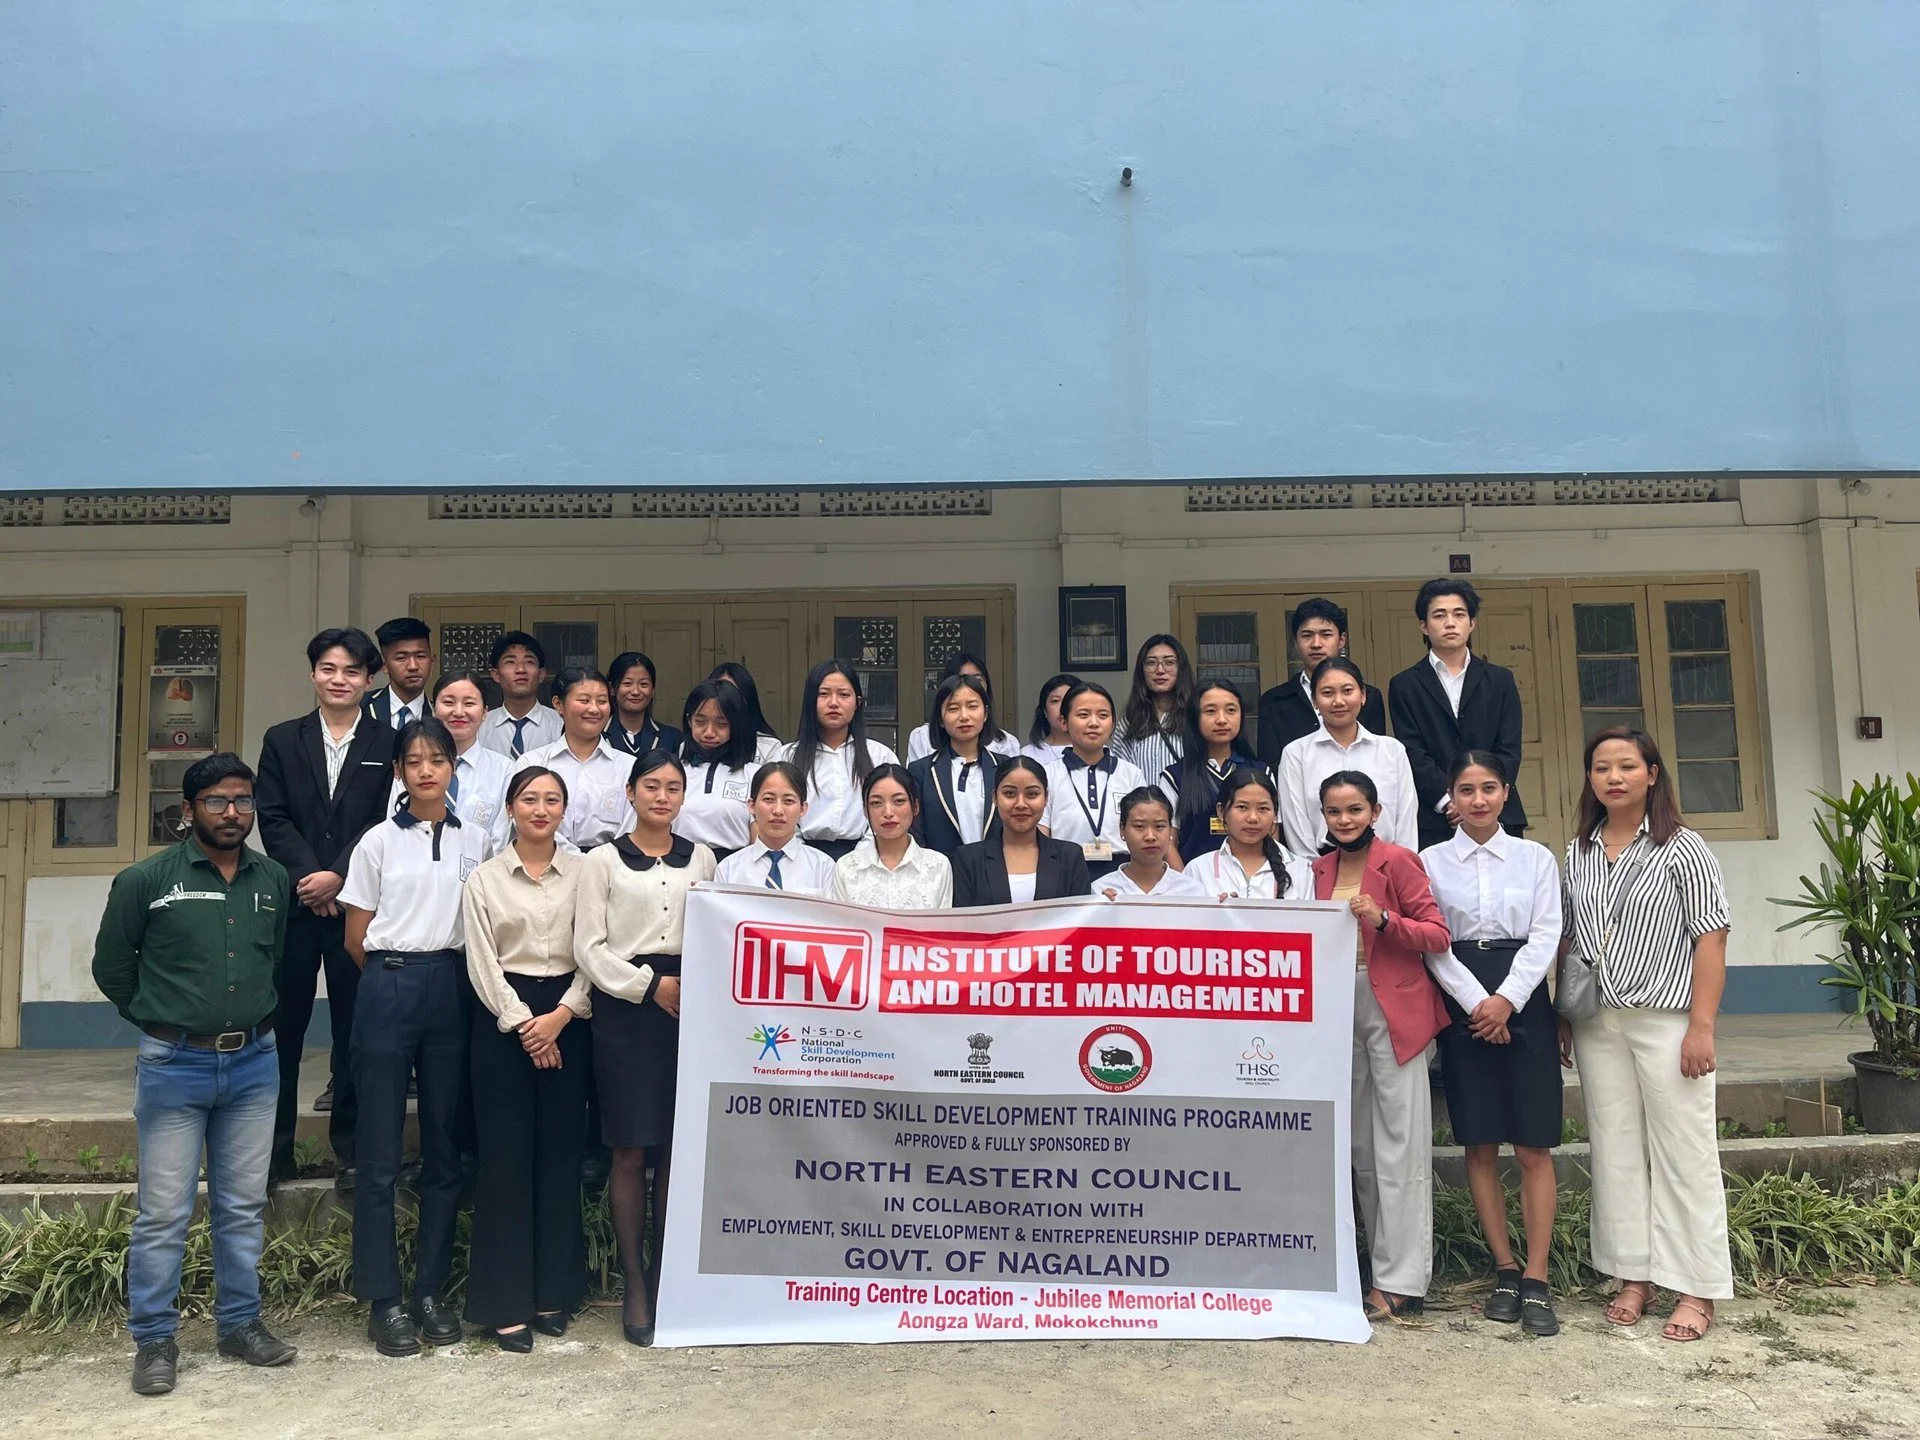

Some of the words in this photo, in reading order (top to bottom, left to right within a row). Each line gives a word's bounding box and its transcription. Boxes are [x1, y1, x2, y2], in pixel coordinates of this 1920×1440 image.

[888, 944, 1073, 973] INSTITUTE
[1081, 944, 1124, 974] OF
[1131, 946, 1302, 979] TOURISM
[886, 979, 960, 1006] AND
[969, 981, 1068, 1008] HOTEL
[1075, 982, 1305, 1014] MANAGEMENT
[801, 1038, 844, 1048] National
[801, 1045, 823, 1055] Skill
[826, 1047, 895, 1060] Development
[800, 1054, 862, 1065] Corporation
[1235, 1063, 1280, 1076] THSC
[753, 1066, 812, 1077] Transforming
[813, 1069, 829, 1077] the
[830, 1070, 849, 1079] skill
[850, 1071, 895, 1082] landscape
[934, 1069, 959, 1078] NORTH
[960, 1070, 992, 1079] EASTERN
[993, 1070, 1025, 1079] COUNCIL
[1083, 1063, 1113, 1091] GOVERNMENT
[1124, 1065, 1149, 1090] NAGALAND
[725, 1095, 762, 1115] JOB
[768, 1097, 867, 1119] ORIENTED
[873, 1101, 927, 1123] SKILL
[934, 1104, 1078, 1126] DEVELOPMENT
[1083, 1106, 1177, 1127] TRAINING
[1184, 1108, 1313, 1131] PROGRAMME
[894, 1132, 967, 1150] APPROVED
[971, 1135, 981, 1151] &
[985, 1136, 1027, 1152] FULLY
[1029, 1136, 1110, 1153] SPONSORED
[1114, 1137, 1131, 1152] BY
[795, 1159, 911, 1183] NORTH
[926, 1165, 1078, 1189] EASTERN
[1091, 1168, 1242, 1192] COUNCIL
[884, 1197, 905, 1212] IN
[912, 1197, 1083, 1218] COLLABORATION
[1090, 1202, 1144, 1218] WITH
[721, 1218, 835, 1238] EMPLOYMENT,
[840, 1222, 886, 1239] SKILL
[891, 1224, 1010, 1242] DEVELOPMENT
[1015, 1227, 1027, 1242] &
[1032, 1228, 1199, 1247] ENTREPRENEURSHIP
[1204, 1231, 1317, 1252] DEPARTMENT,
[844, 1247, 933, 1272] GOVT.
[945, 1250, 987, 1273] OF
[998, 1251, 1171, 1278] NAGALAND
[785, 1281, 861, 1307] Training
[866, 1283, 928, 1304] Centre
[933, 1285, 1014, 1306] Location
[1034, 1288, 1102, 1309] Jubilee
[1108, 1290, 1196, 1310] Memorial
[1202, 1292, 1273, 1316] College
[897, 1310, 968, 1332] Aongza
[974, 1313, 1030, 1330] Ward,
[1034, 1314, 1159, 1330] Mokokchung
